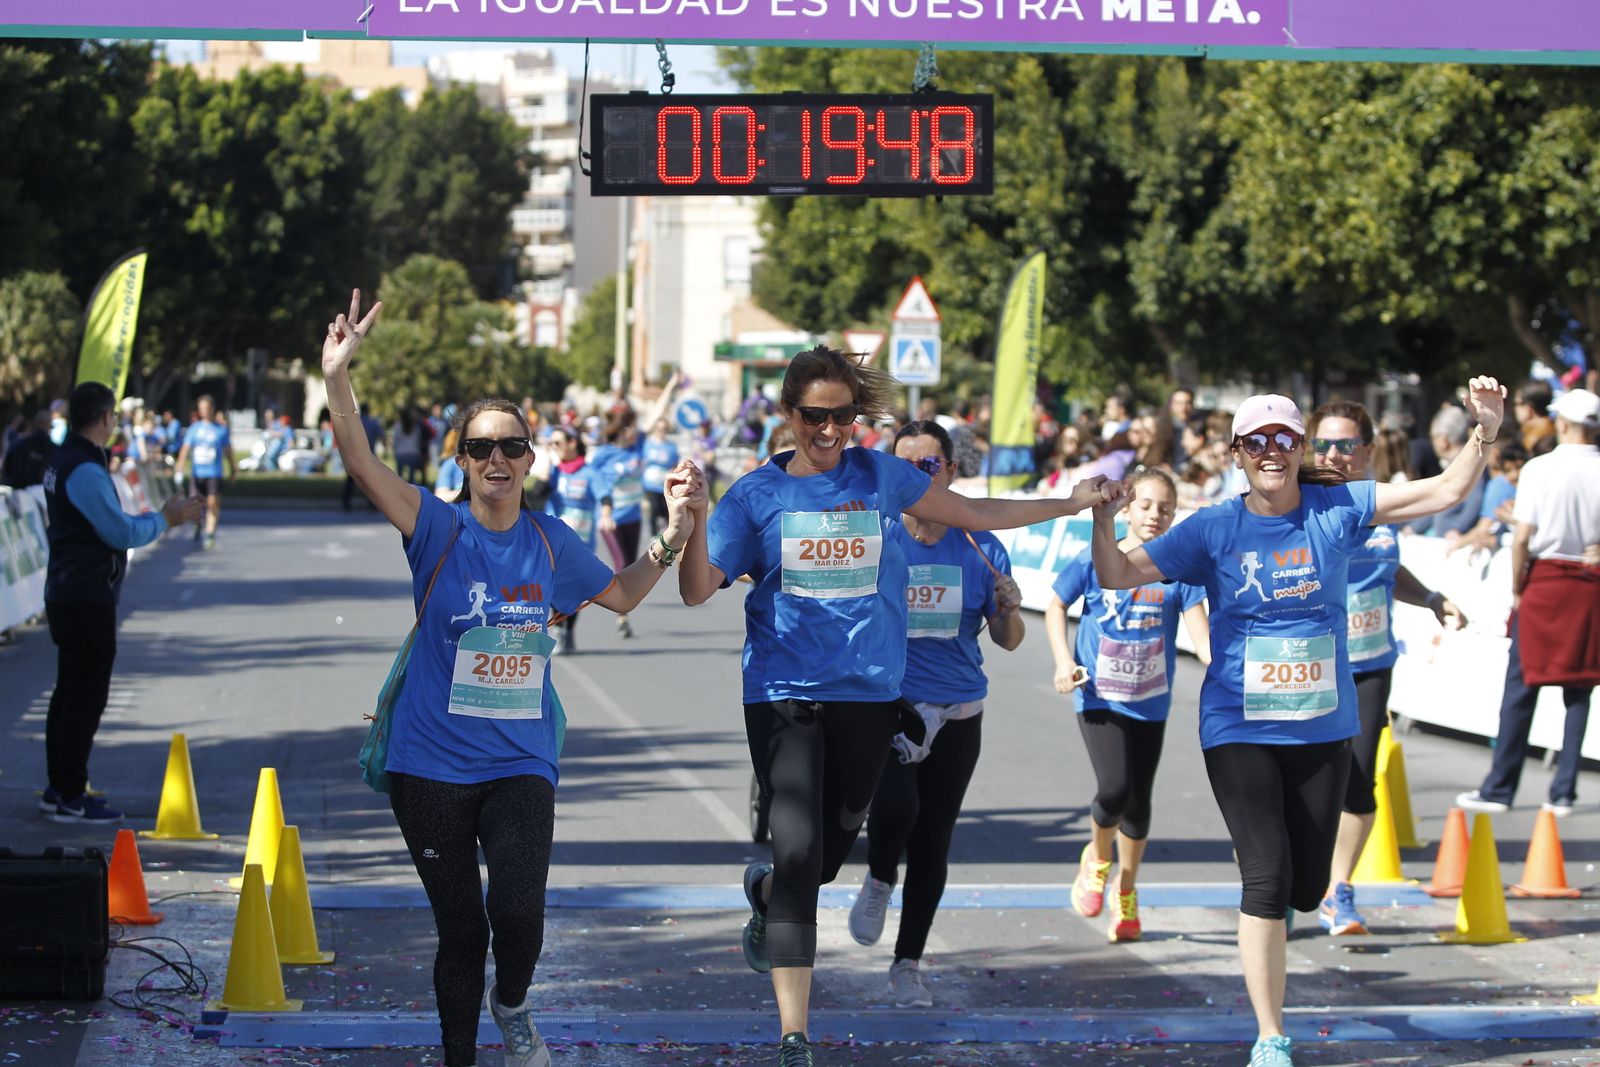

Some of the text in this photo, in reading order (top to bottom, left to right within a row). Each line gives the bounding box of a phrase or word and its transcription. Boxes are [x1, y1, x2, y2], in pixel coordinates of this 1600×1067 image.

[799, 538, 865, 560] 2096
[1272, 566, 1317, 579] CARRERA
[501, 584, 543, 603] VIII
[906, 586, 946, 604] 097
[500, 606, 545, 615] CARRERA
[472, 653, 533, 677] 2095
[1261, 661, 1322, 683] 2030
[478, 676, 525, 685] M.J. CARRILLO
